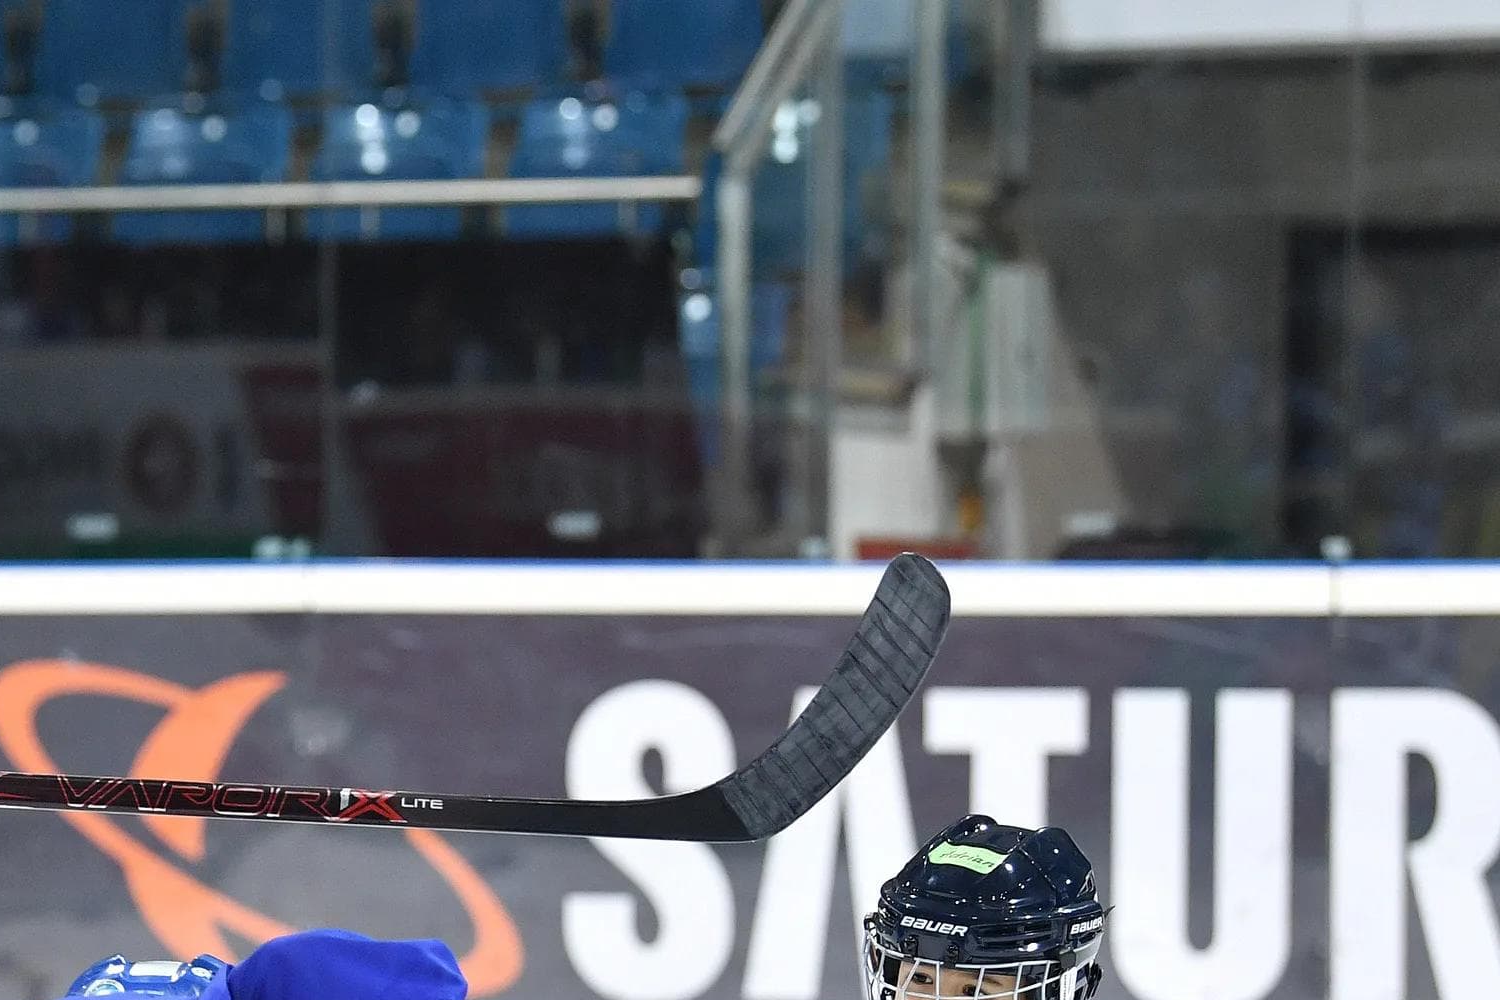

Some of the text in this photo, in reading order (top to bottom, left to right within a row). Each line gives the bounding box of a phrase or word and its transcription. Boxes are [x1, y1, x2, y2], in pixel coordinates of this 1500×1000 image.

[57, 774, 346, 822] VAPOR
[401, 797, 444, 810] LITE
[900, 914, 969, 937] BAUER
